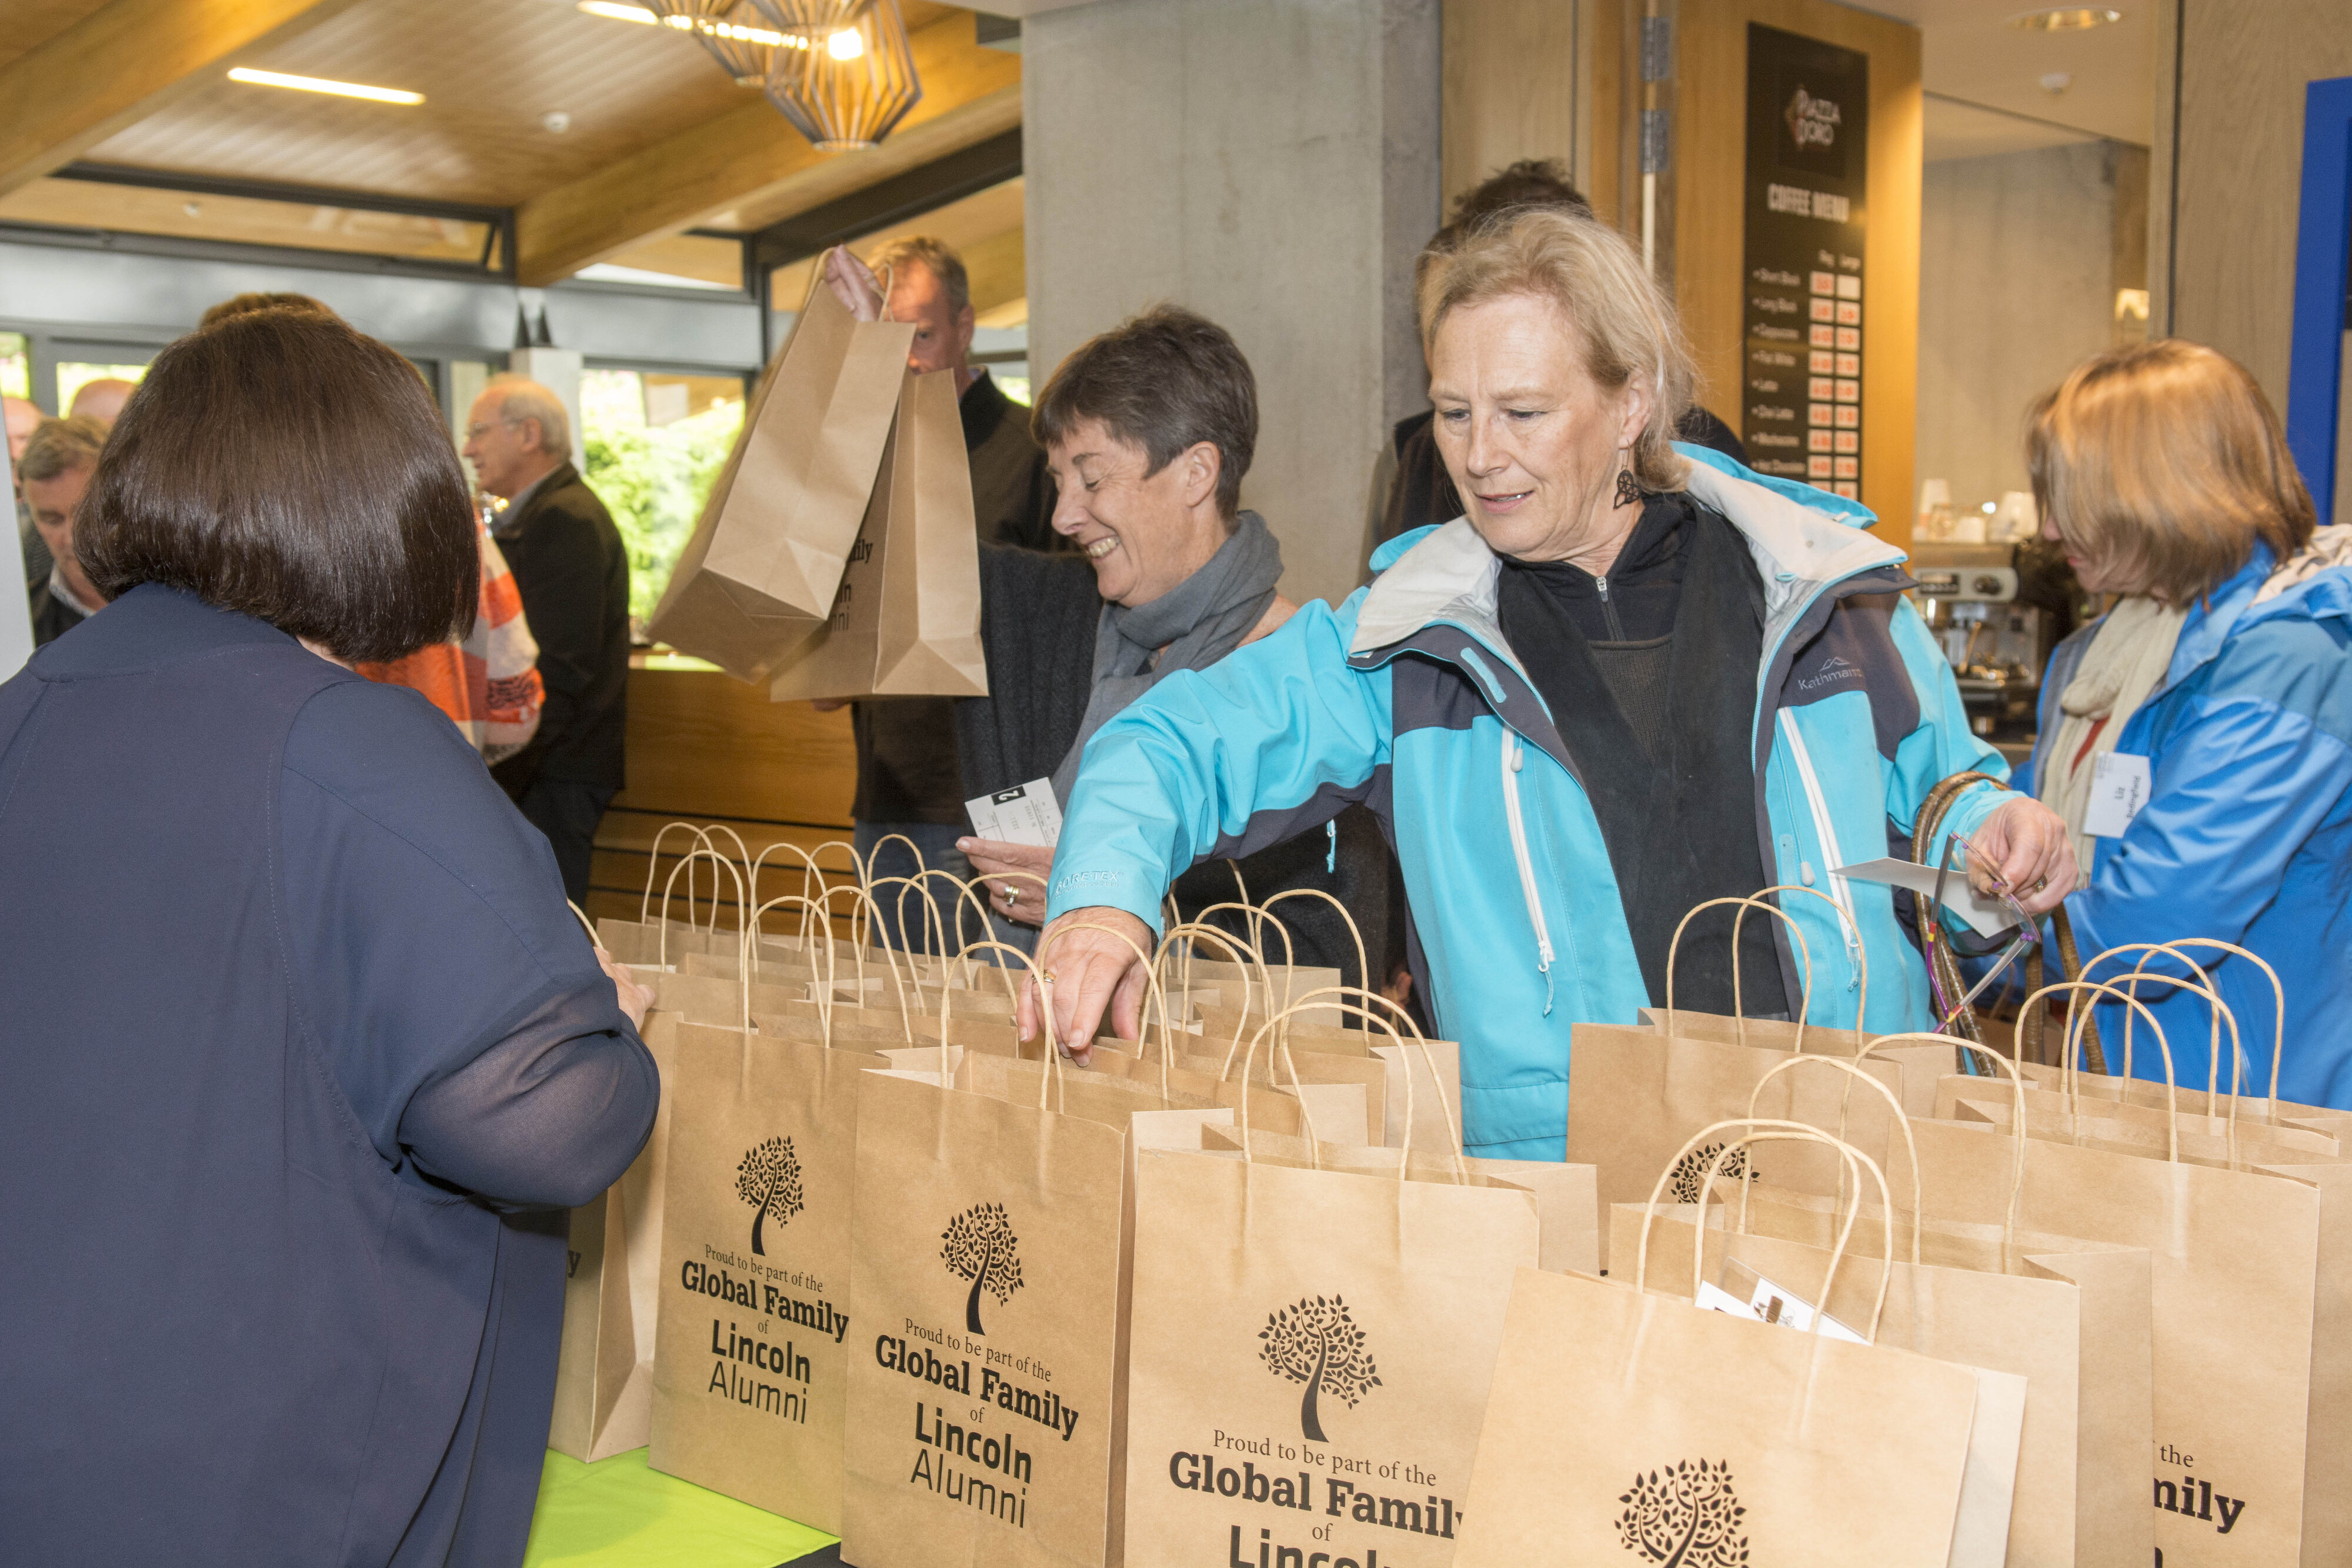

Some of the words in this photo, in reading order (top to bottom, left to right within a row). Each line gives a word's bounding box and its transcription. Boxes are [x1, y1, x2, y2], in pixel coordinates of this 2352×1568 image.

[1767, 183, 1810, 217] COFFEE
[1812, 191, 1850, 225] MENU
[998, 790, 1019, 800] 2
[2114, 786, 2125, 799] Liz
[706, 1244, 734, 1266] Proud
[738, 1257, 748, 1270] to
[751, 1257, 763, 1275] be
[766, 1265, 788, 1282] part
[792, 1272, 803, 1286] of
[806, 1275, 823, 1293] the
[681, 1260, 758, 1310] Global
[763, 1284, 849, 1344] Family
[758, 1320, 769, 1334] of
[712, 1319, 810, 1384] Lincoln
[905, 1318, 943, 1345] Proud
[948, 1334, 960, 1350] to
[965, 1336, 981, 1356] be
[986, 1347, 1012, 1367] part
[1016, 1357, 1030, 1373] of
[1032, 1361, 1051, 1382] the
[709, 1360, 807, 1424] Alumni
[875, 1335, 970, 1396] Global
[980, 1367, 1079, 1442] Family
[970, 1407, 985, 1423] of
[915, 1402, 1032, 1484] Lincoln
[1213, 1429, 1271, 1456] Proud
[1277, 1443, 1296, 1460] to
[1303, 1444, 1325, 1466] be
[1332, 1456, 1372, 1475] part
[1379, 1462, 1400, 1480] of
[1405, 1464, 1436, 1486] the
[2160, 1444, 2194, 1468] the
[910, 1448, 1026, 1529] Alumni
[1169, 1451, 1312, 1512] Global
[1326, 1477, 1463, 1540] Famil
[2154, 1476, 2246, 1534] mily
[1312, 1523, 1333, 1542] of
